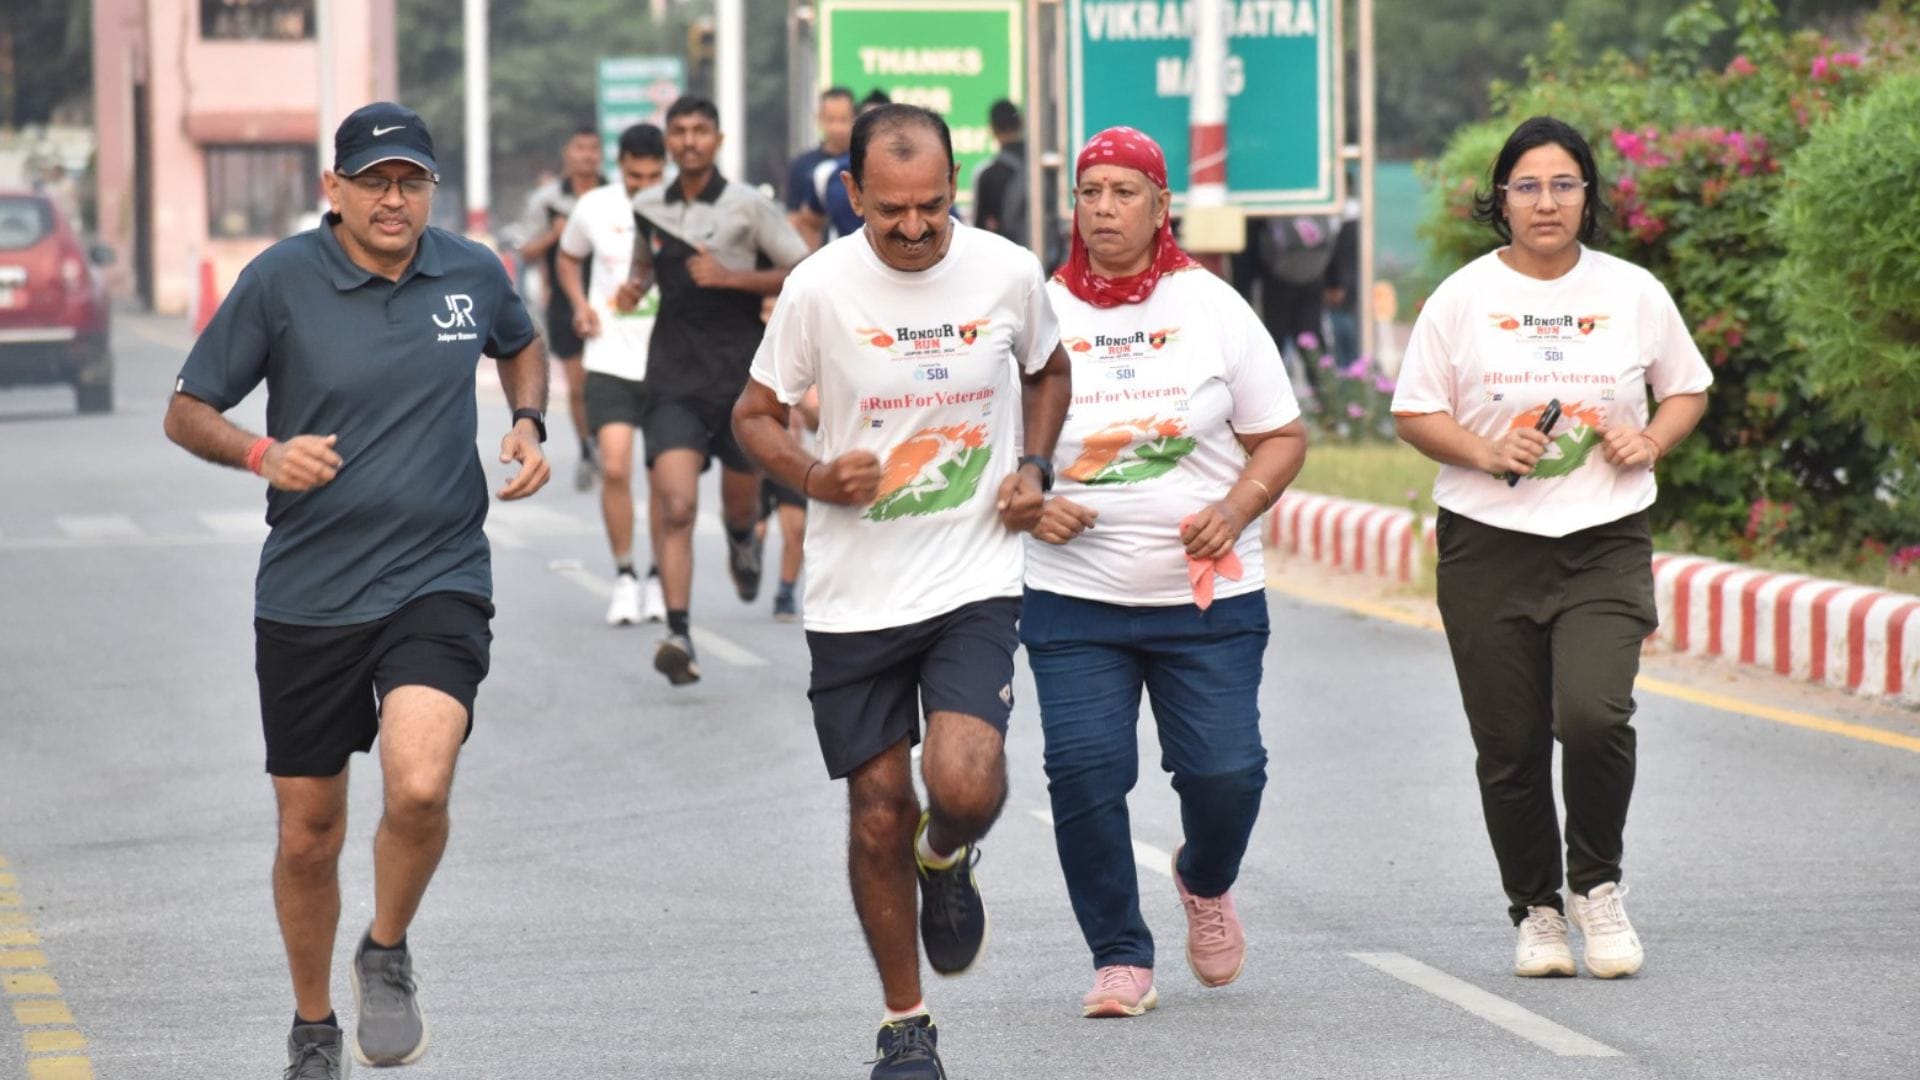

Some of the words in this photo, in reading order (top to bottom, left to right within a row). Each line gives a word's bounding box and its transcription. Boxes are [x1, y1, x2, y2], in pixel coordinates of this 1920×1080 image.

[859, 47, 982, 75] THANKS
[1156, 56, 1245, 97] MAG
[1523, 315, 1573, 326] HONOUR
[896, 324, 954, 341] HONOUR
[1095, 331, 1144, 347] HONOUR
[914, 338, 941, 350] RUN
[1108, 345, 1131, 354] RUN
[1545, 351, 1563, 361] SBI
[927, 367, 949, 380] SBI
[1116, 368, 1135, 379] SBI
[1483, 371, 1616, 385] #RunForVeterans
[859, 386, 995, 411] #RunForVeterans
[1070, 386, 1187, 406] unForVeterans
